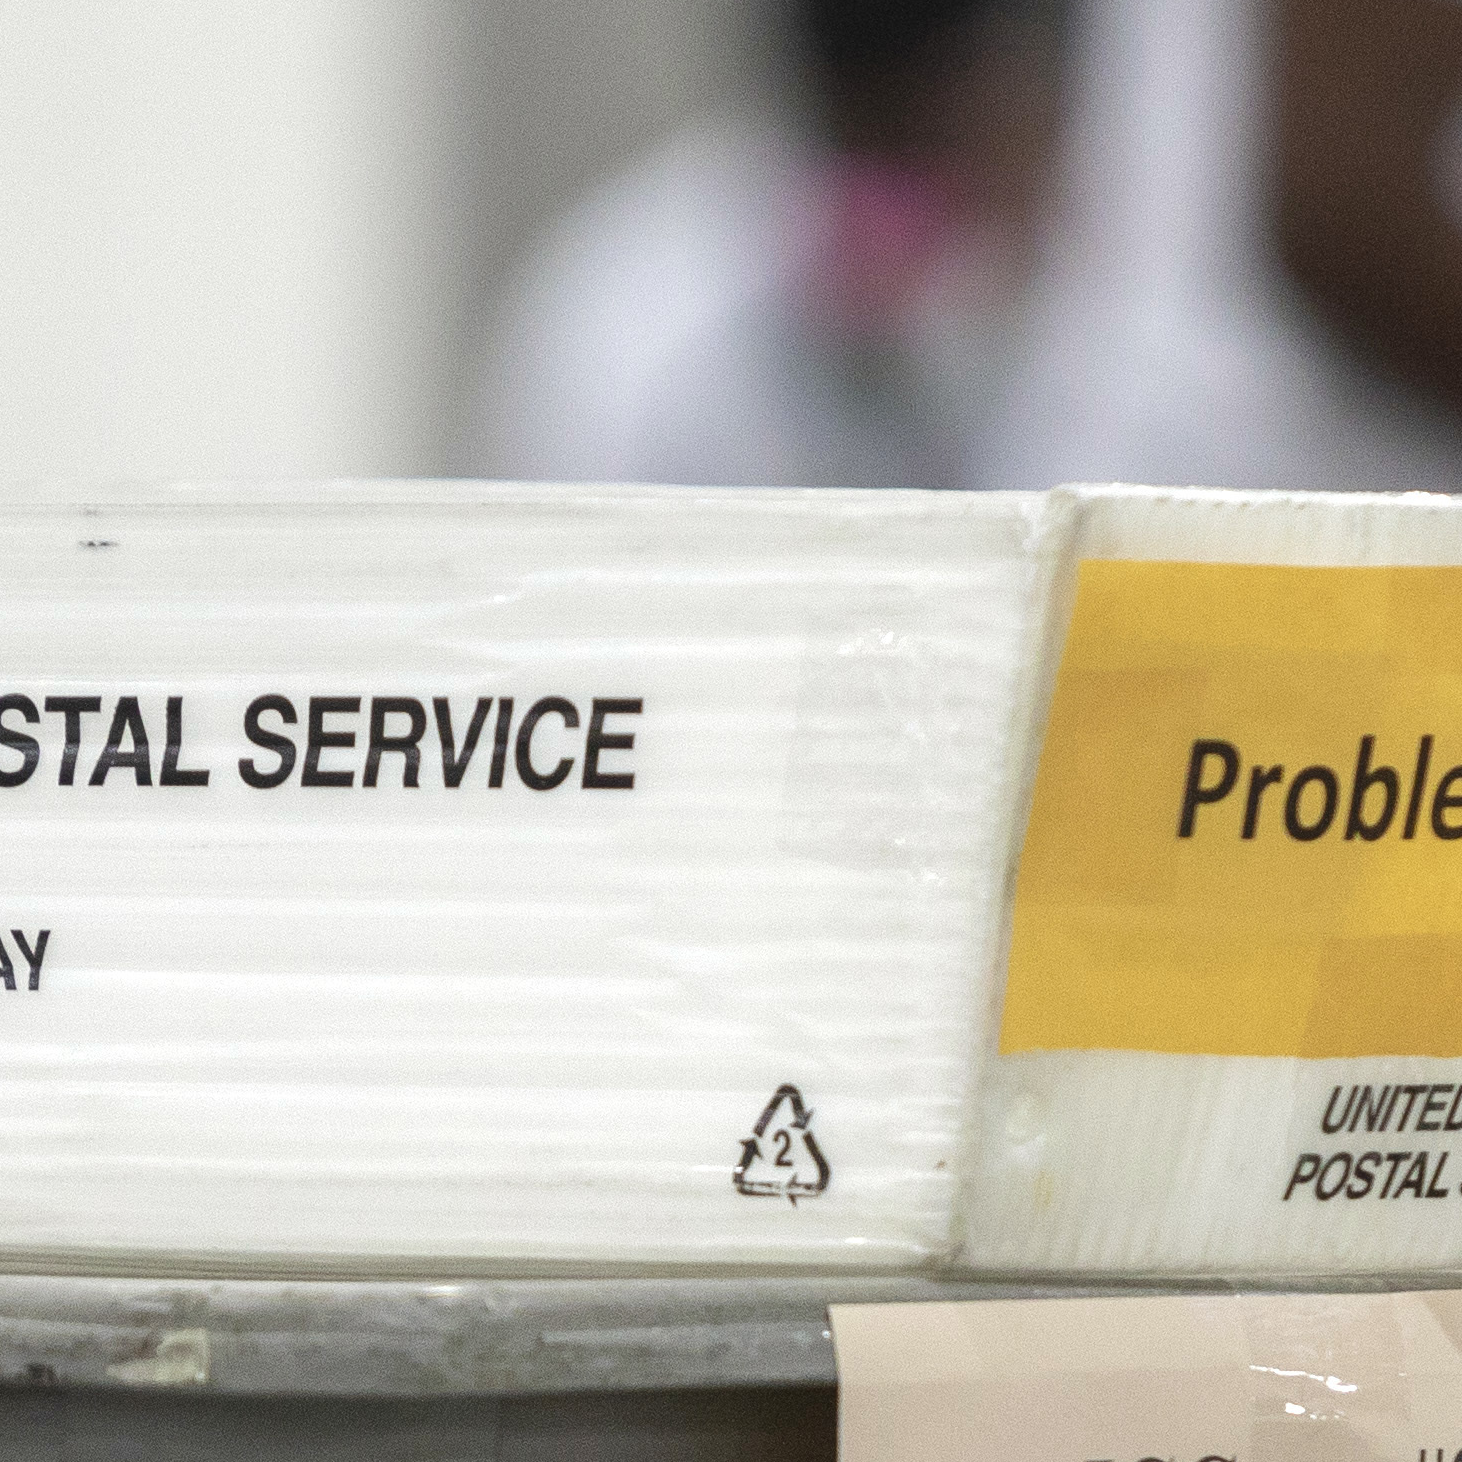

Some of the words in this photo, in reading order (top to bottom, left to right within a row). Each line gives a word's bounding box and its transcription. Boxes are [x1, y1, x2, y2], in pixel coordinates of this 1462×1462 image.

[237, 693, 644, 792] SERVICE
[772, 1128, 794, 1167] 2
[1282, 1155, 1449, 1202] POSTAL
